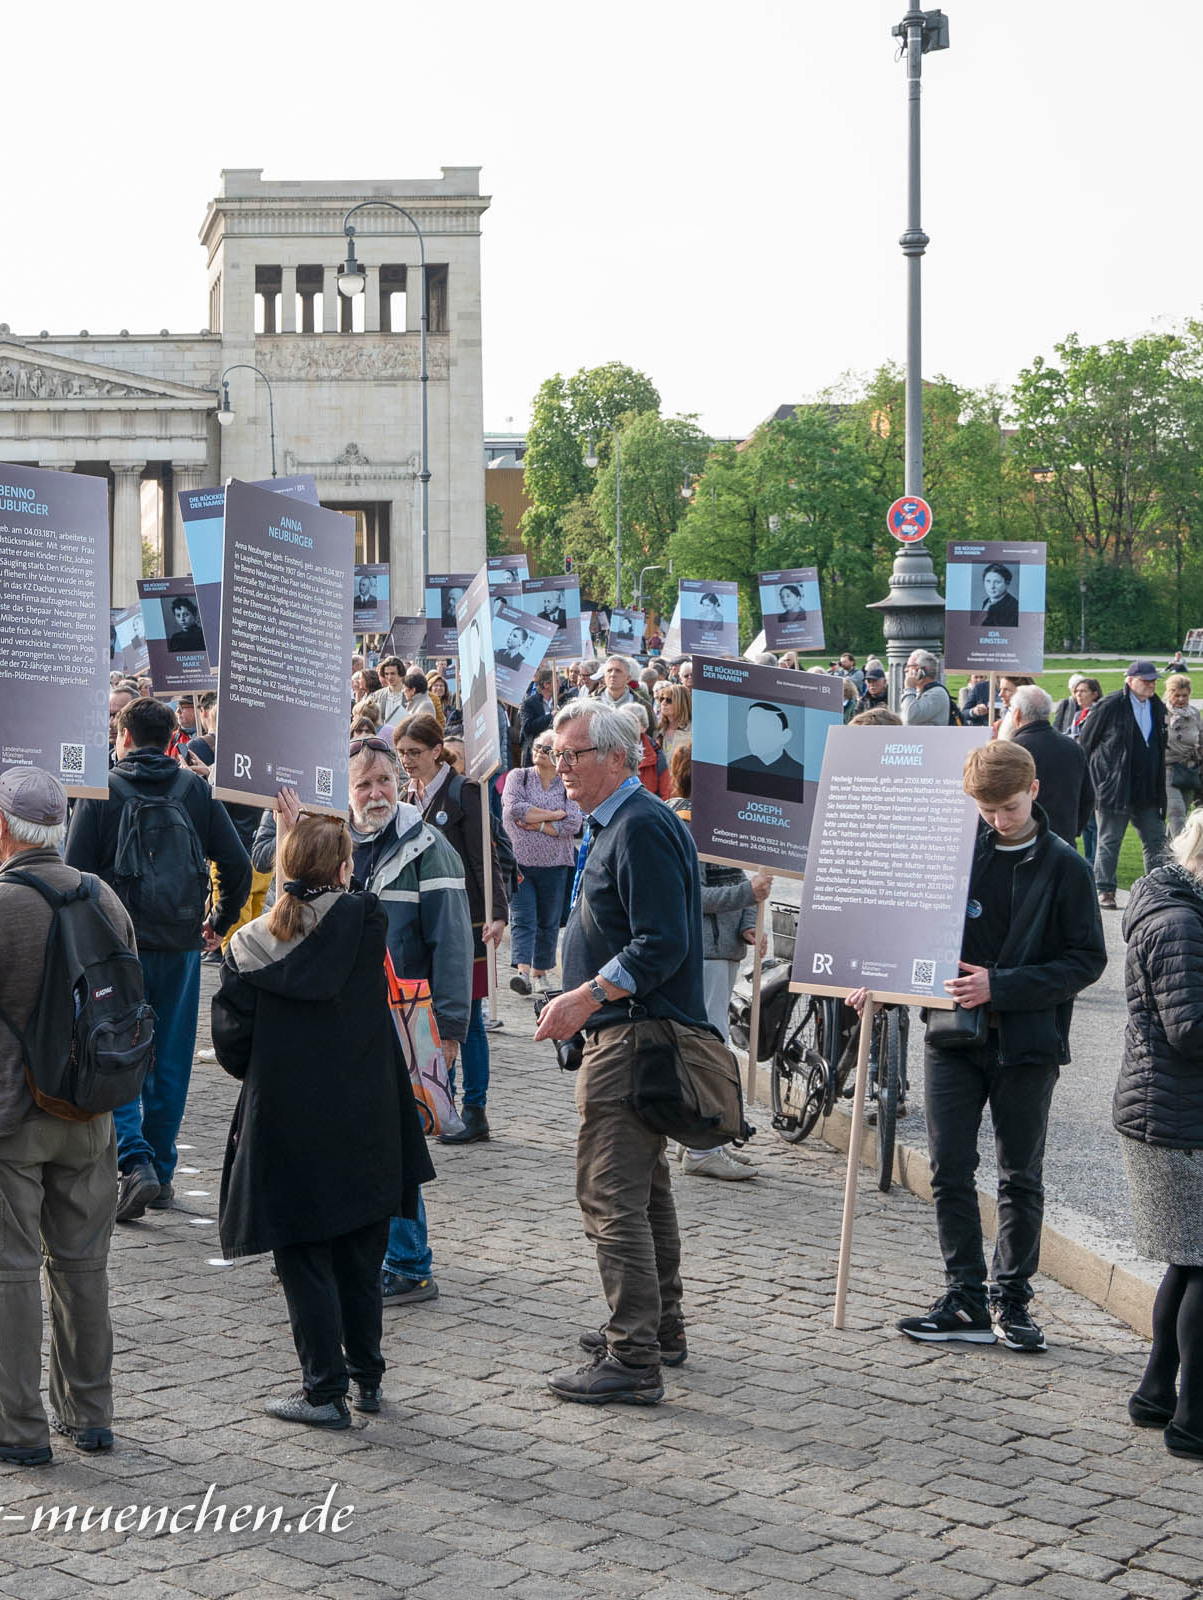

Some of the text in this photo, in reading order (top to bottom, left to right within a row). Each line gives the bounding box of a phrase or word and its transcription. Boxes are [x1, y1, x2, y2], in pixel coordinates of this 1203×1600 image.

[280, 516, 302, 532] ANNA
[58, 532, 86, 543] arbeitete
[88, 535, 94, 544] in
[269, 527, 313, 548] NEUBURGER
[46, 541, 57, 550] Mit
[60, 543, 78, 553] seiner
[81, 545, 94, 554] Frau
[3, 580, 9, 588] in
[10, 581, 21, 590] das
[23, 582, 31, 590] KZ
[33, 583, 56, 594] Dachau
[16, 626, 30, 636] früh
[31, 628, 41, 636] die
[75, 621, 95, 631] Benno
[0, 635, 12, 645] und
[14, 637, 50, 649] verschickte
[52, 643, 77, 653] anonym
[703, 665, 749, 678] DIE RÜCKKEHR
[703, 671, 743, 683] DER NAMEN
[822, 686, 830, 694] BR
[885, 744, 924, 754] HEDWIG
[234, 753, 252, 780] BR
[880, 755, 923, 766] HAMMEL
[746, 802, 782, 816] JOSEPH
[738, 811, 791, 829] GOJMERAC
[713, 828, 738, 838] Geboren
[712, 836, 738, 846] Ermordet
[812, 952, 833, 975] BR
